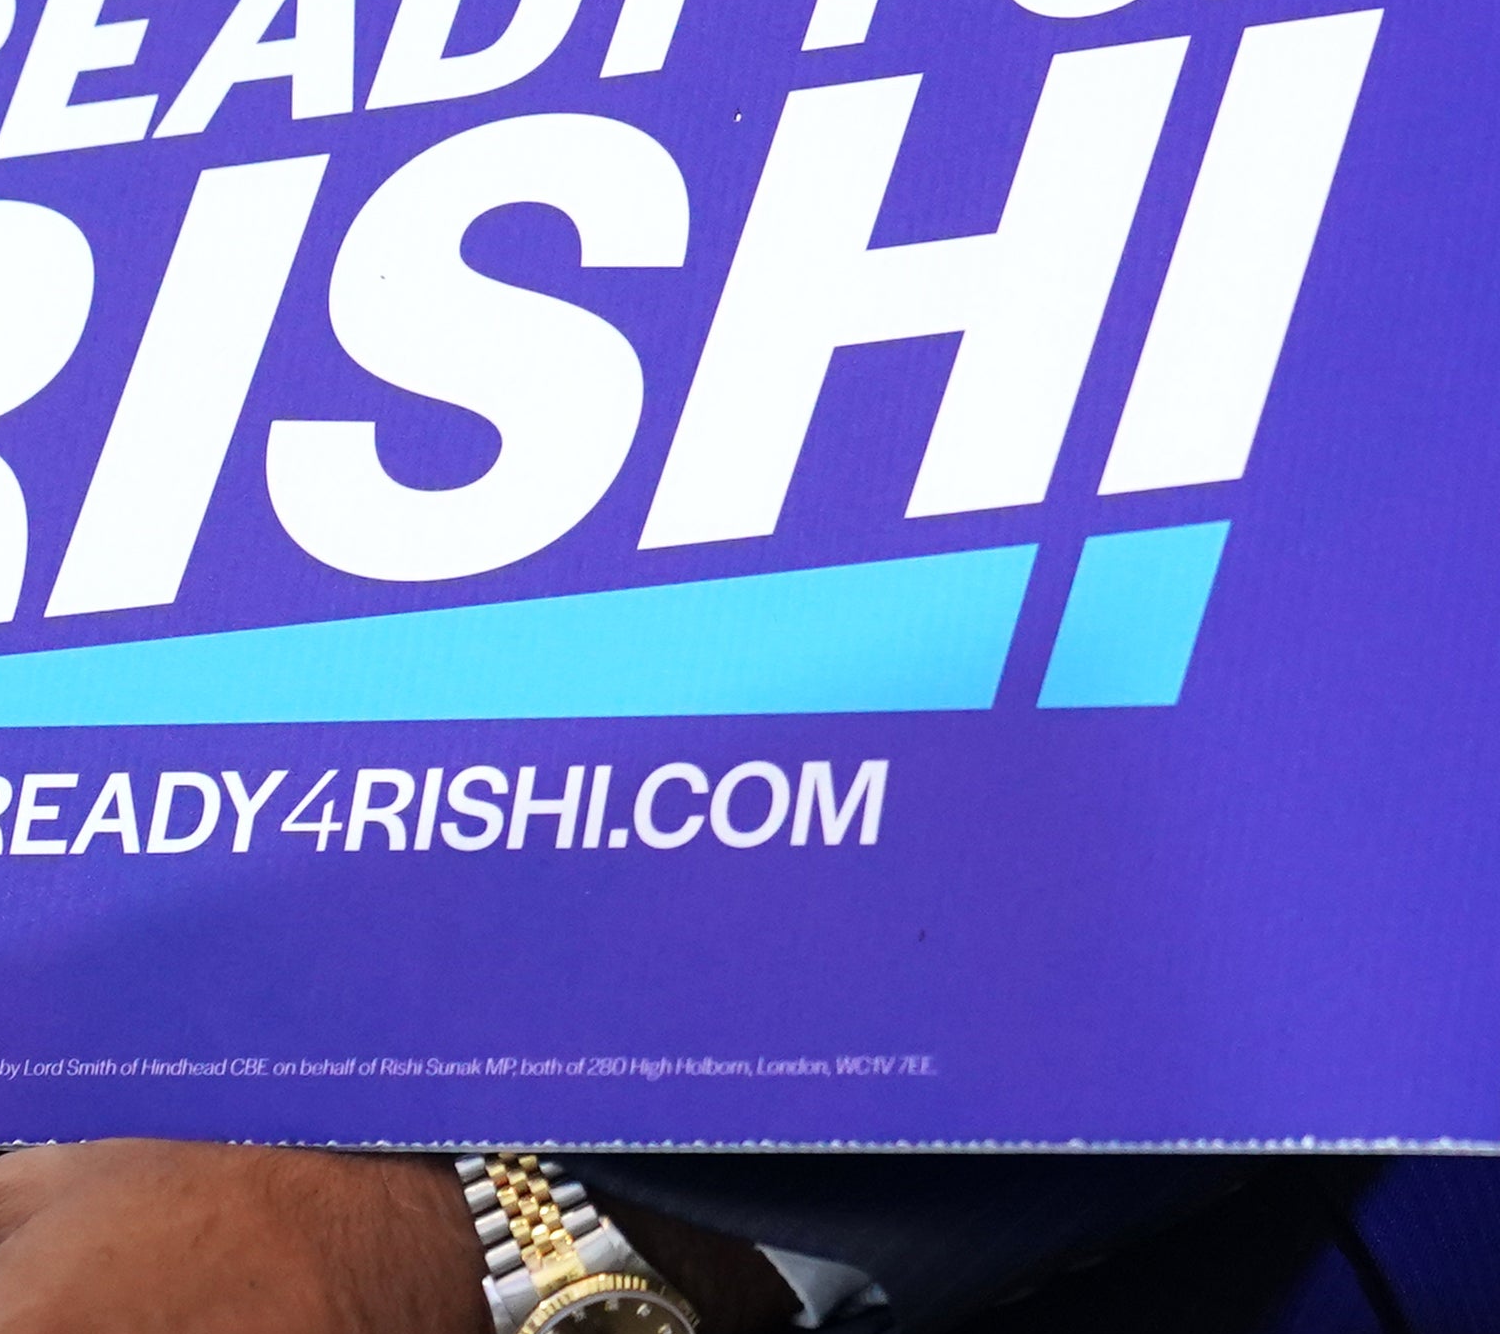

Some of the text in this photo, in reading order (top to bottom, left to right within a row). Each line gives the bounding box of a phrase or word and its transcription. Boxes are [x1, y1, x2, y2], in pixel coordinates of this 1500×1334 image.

[23, 1058, 65, 1076] Lord
[66, 1058, 118, 1076] Smith
[120, 1058, 141, 1076] of
[140, 1058, 229, 1076] Hindhead
[230, 1058, 270, 1076] CBE
[272, 1062, 298, 1076] on
[299, 1058, 357, 1076] behalf
[358, 1058, 378, 1076] of
[379, 1058, 424, 1076] Rishi
[425, 1058, 483, 1076] Sunak
[485, 1058, 519, 1078] MP,
[520, 1058, 564, 1076] both
[566, 1058, 586, 1076] of
[587, 1058, 627, 1076] 280
[629, 1057, 673, 1082] High
[675, 1056, 754, 1077] Holborn,
[756, 1056, 833, 1077] London,
